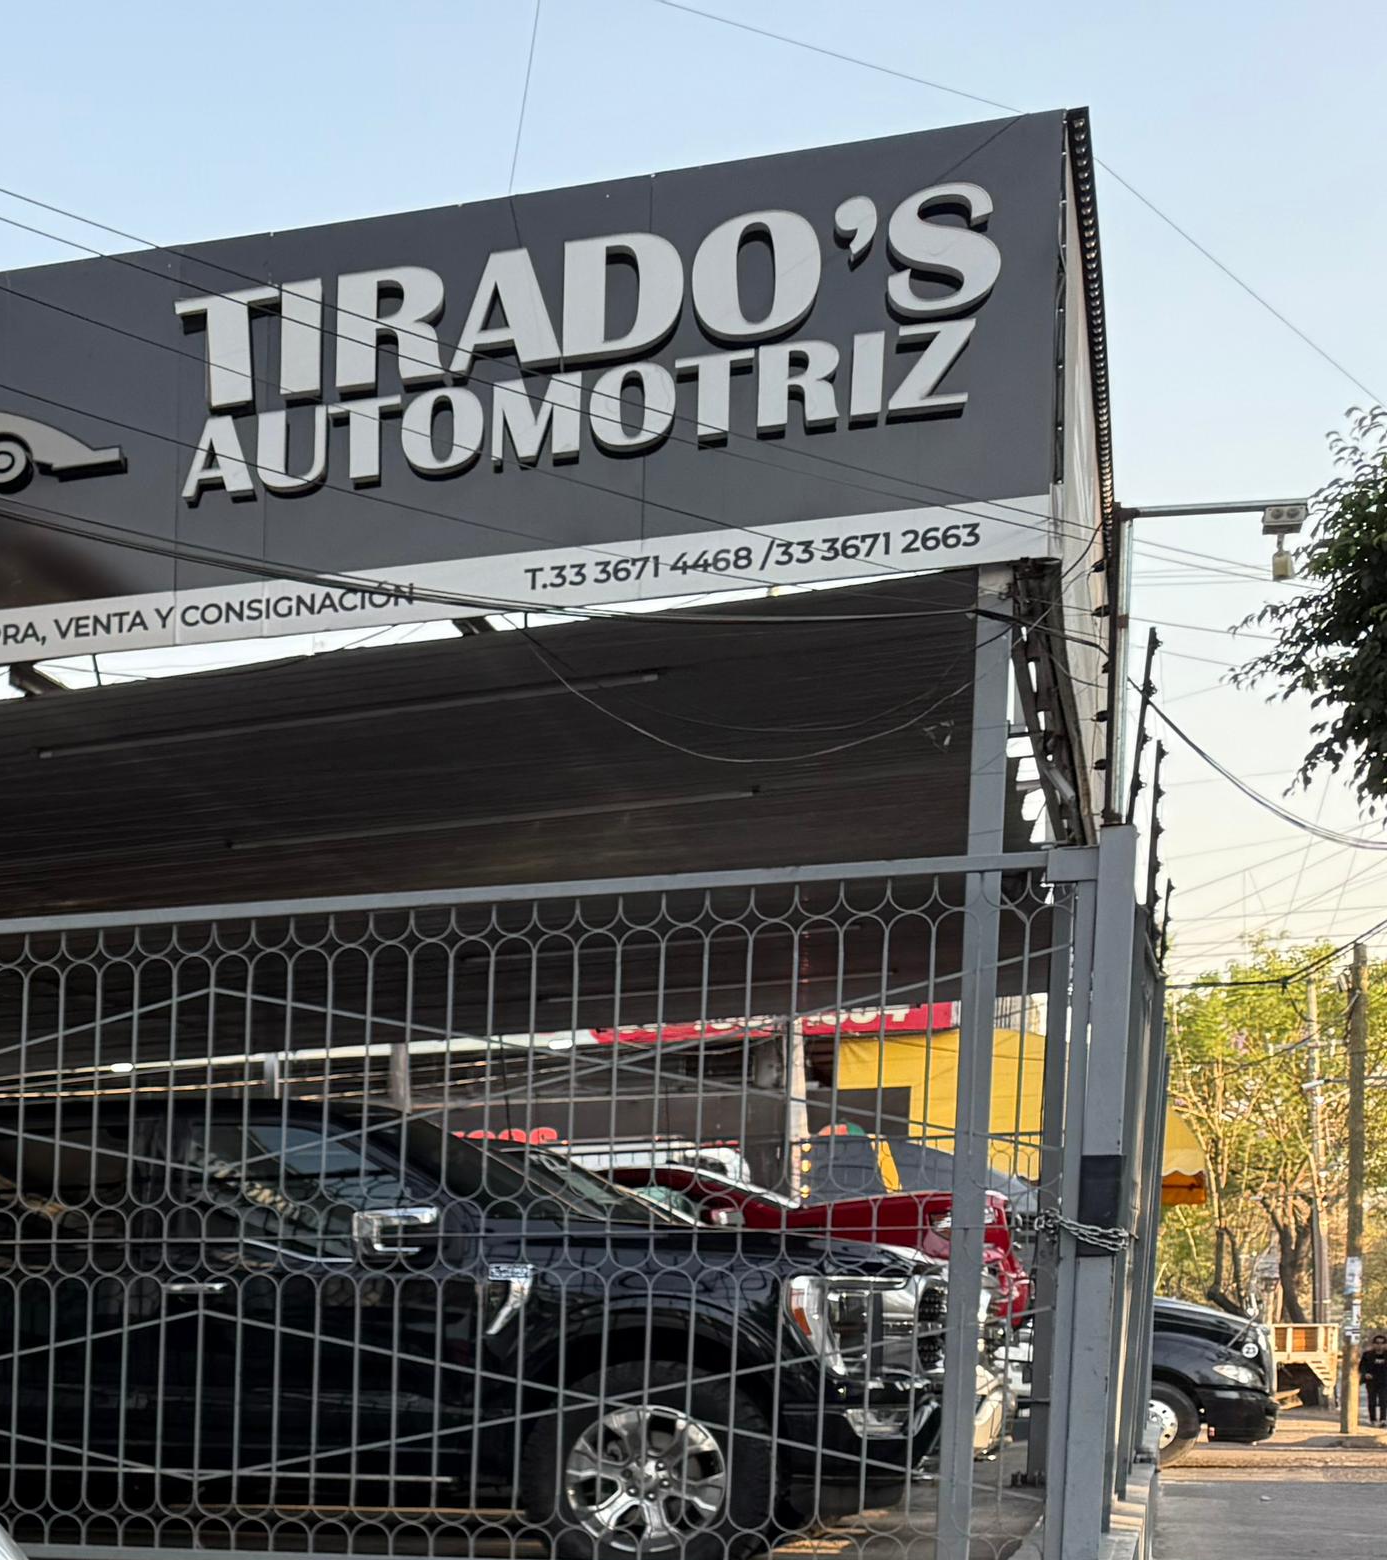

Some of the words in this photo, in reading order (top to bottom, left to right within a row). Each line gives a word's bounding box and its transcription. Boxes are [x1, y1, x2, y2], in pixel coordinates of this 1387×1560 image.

[181, 318, 978, 507] AUTOMOTRIZ
[593, 556, 660, 583] 3671
[670, 546, 753, 575] 4468
[820, 532, 891, 561] 3671
[900, 522, 981, 554] 2663
[54, 610, 148, 640] VENTA
[154, 606, 175, 629] Y
[180, 581, 415, 627] CONSIGNACIÓN
